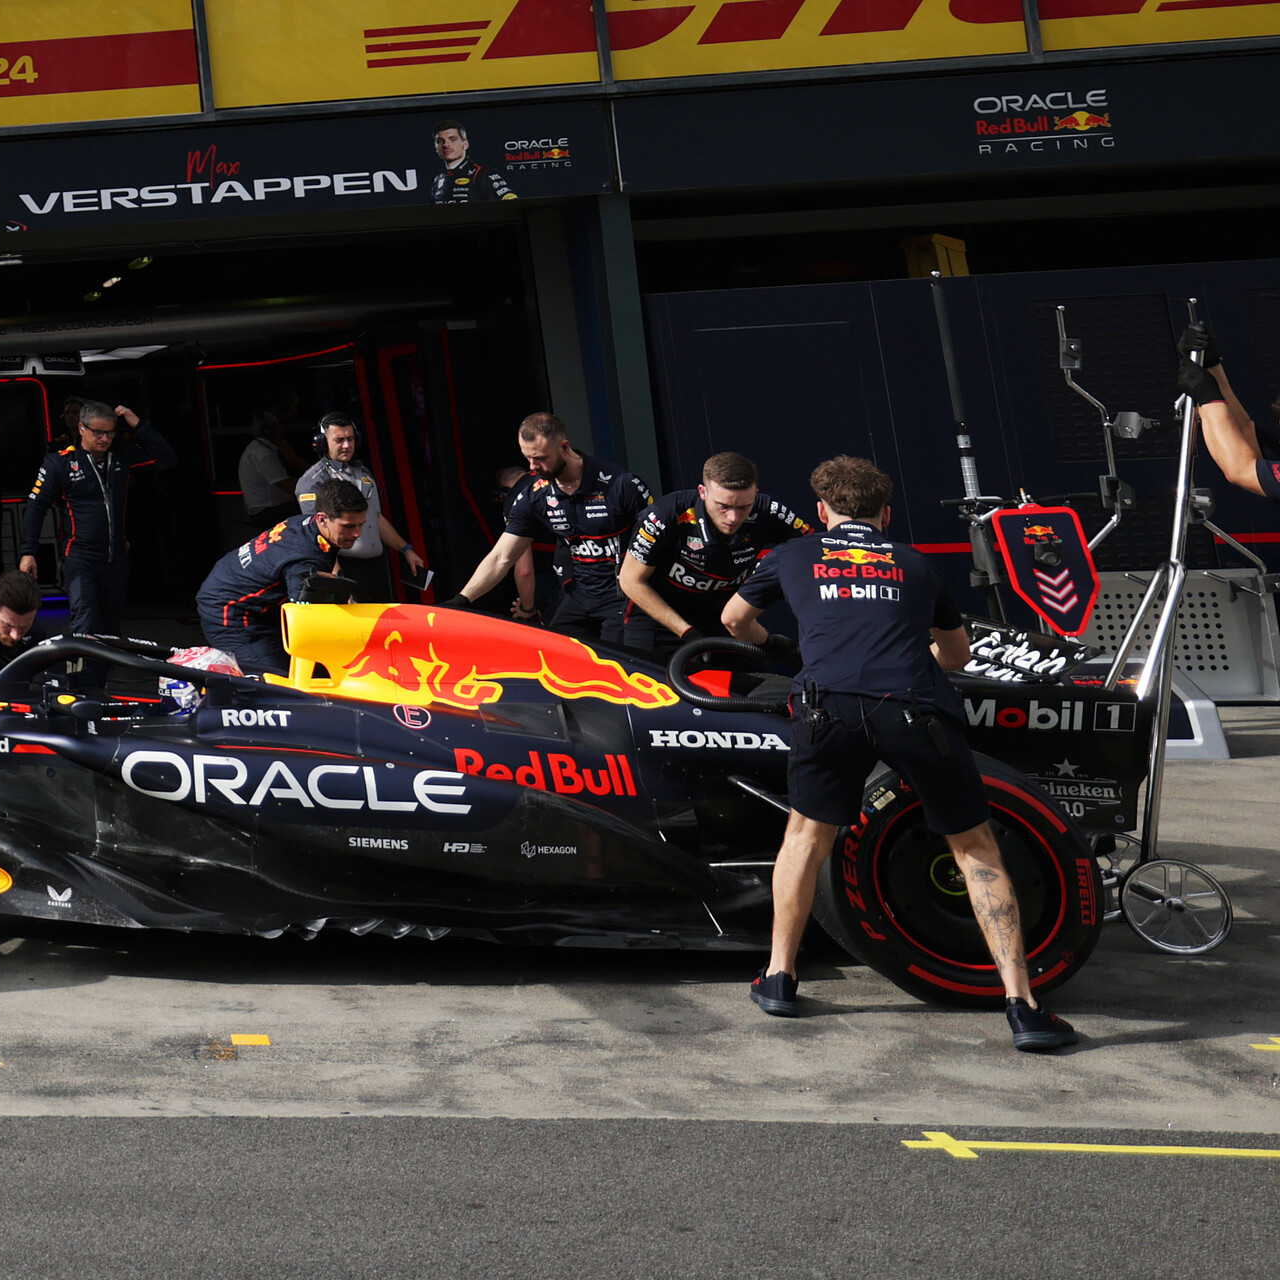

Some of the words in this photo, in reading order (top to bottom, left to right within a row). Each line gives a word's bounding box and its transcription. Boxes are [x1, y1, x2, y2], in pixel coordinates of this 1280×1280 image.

[973, 89, 1108, 114] ORACLE
[976, 118, 1011, 135] Red
[1014, 116, 1049, 133] Bull
[504, 137, 569, 151] ORACLE
[978, 137, 1115, 155] RACING
[186, 144, 241, 189] Max
[505, 152, 523, 163] Red
[524, 151, 541, 162] Bull
[506, 161, 572, 172] RACING
[19, 169, 418, 215] VERSTAPPEN
[840, 524, 873, 532] HONDA
[821, 537, 893, 549] ORACLE
[668, 562, 713, 591] Red
[812, 563, 858, 579] Red
[860, 565, 904, 582] Bull
[819, 584, 877, 600] Mobil
[221, 708, 291, 729] ROKT
[964, 698, 1084, 731] Mobil
[650, 729, 790, 751] HONDA
[453, 747, 544, 791] Red
[547, 752, 638, 797] Bull
[122, 750, 472, 815] ORACLE
[348, 837, 409, 850] SIEMENS
[538, 846, 577, 855] HEXAGON
[1075, 858, 1096, 926] PIRELLI
[859, 921, 886, 941] P
